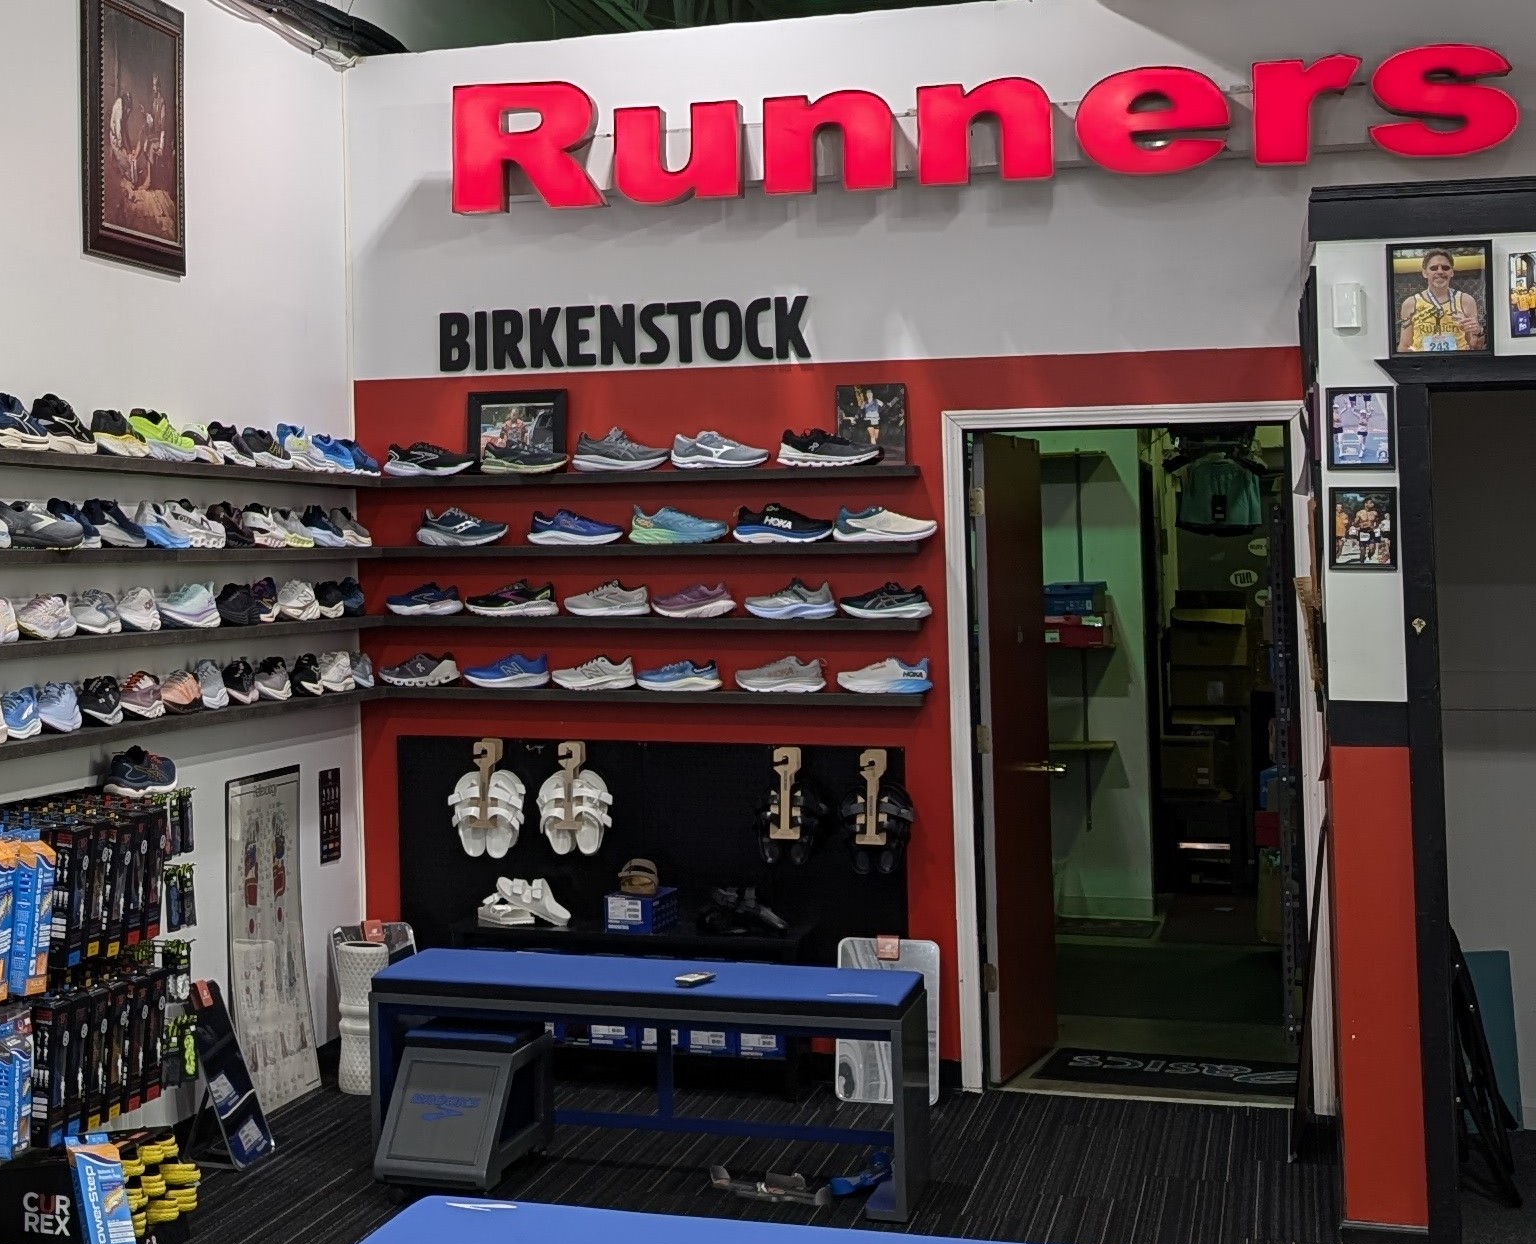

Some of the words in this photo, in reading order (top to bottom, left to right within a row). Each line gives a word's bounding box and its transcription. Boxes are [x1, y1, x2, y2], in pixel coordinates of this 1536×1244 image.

[453, 43, 1519, 213] Runners
[439, 294, 811, 372] BIRKENSTOCK
[764, 515, 793, 529] HOKA
[22, 1191, 71, 1216] CUR
[24, 1212, 71, 1237] REX
